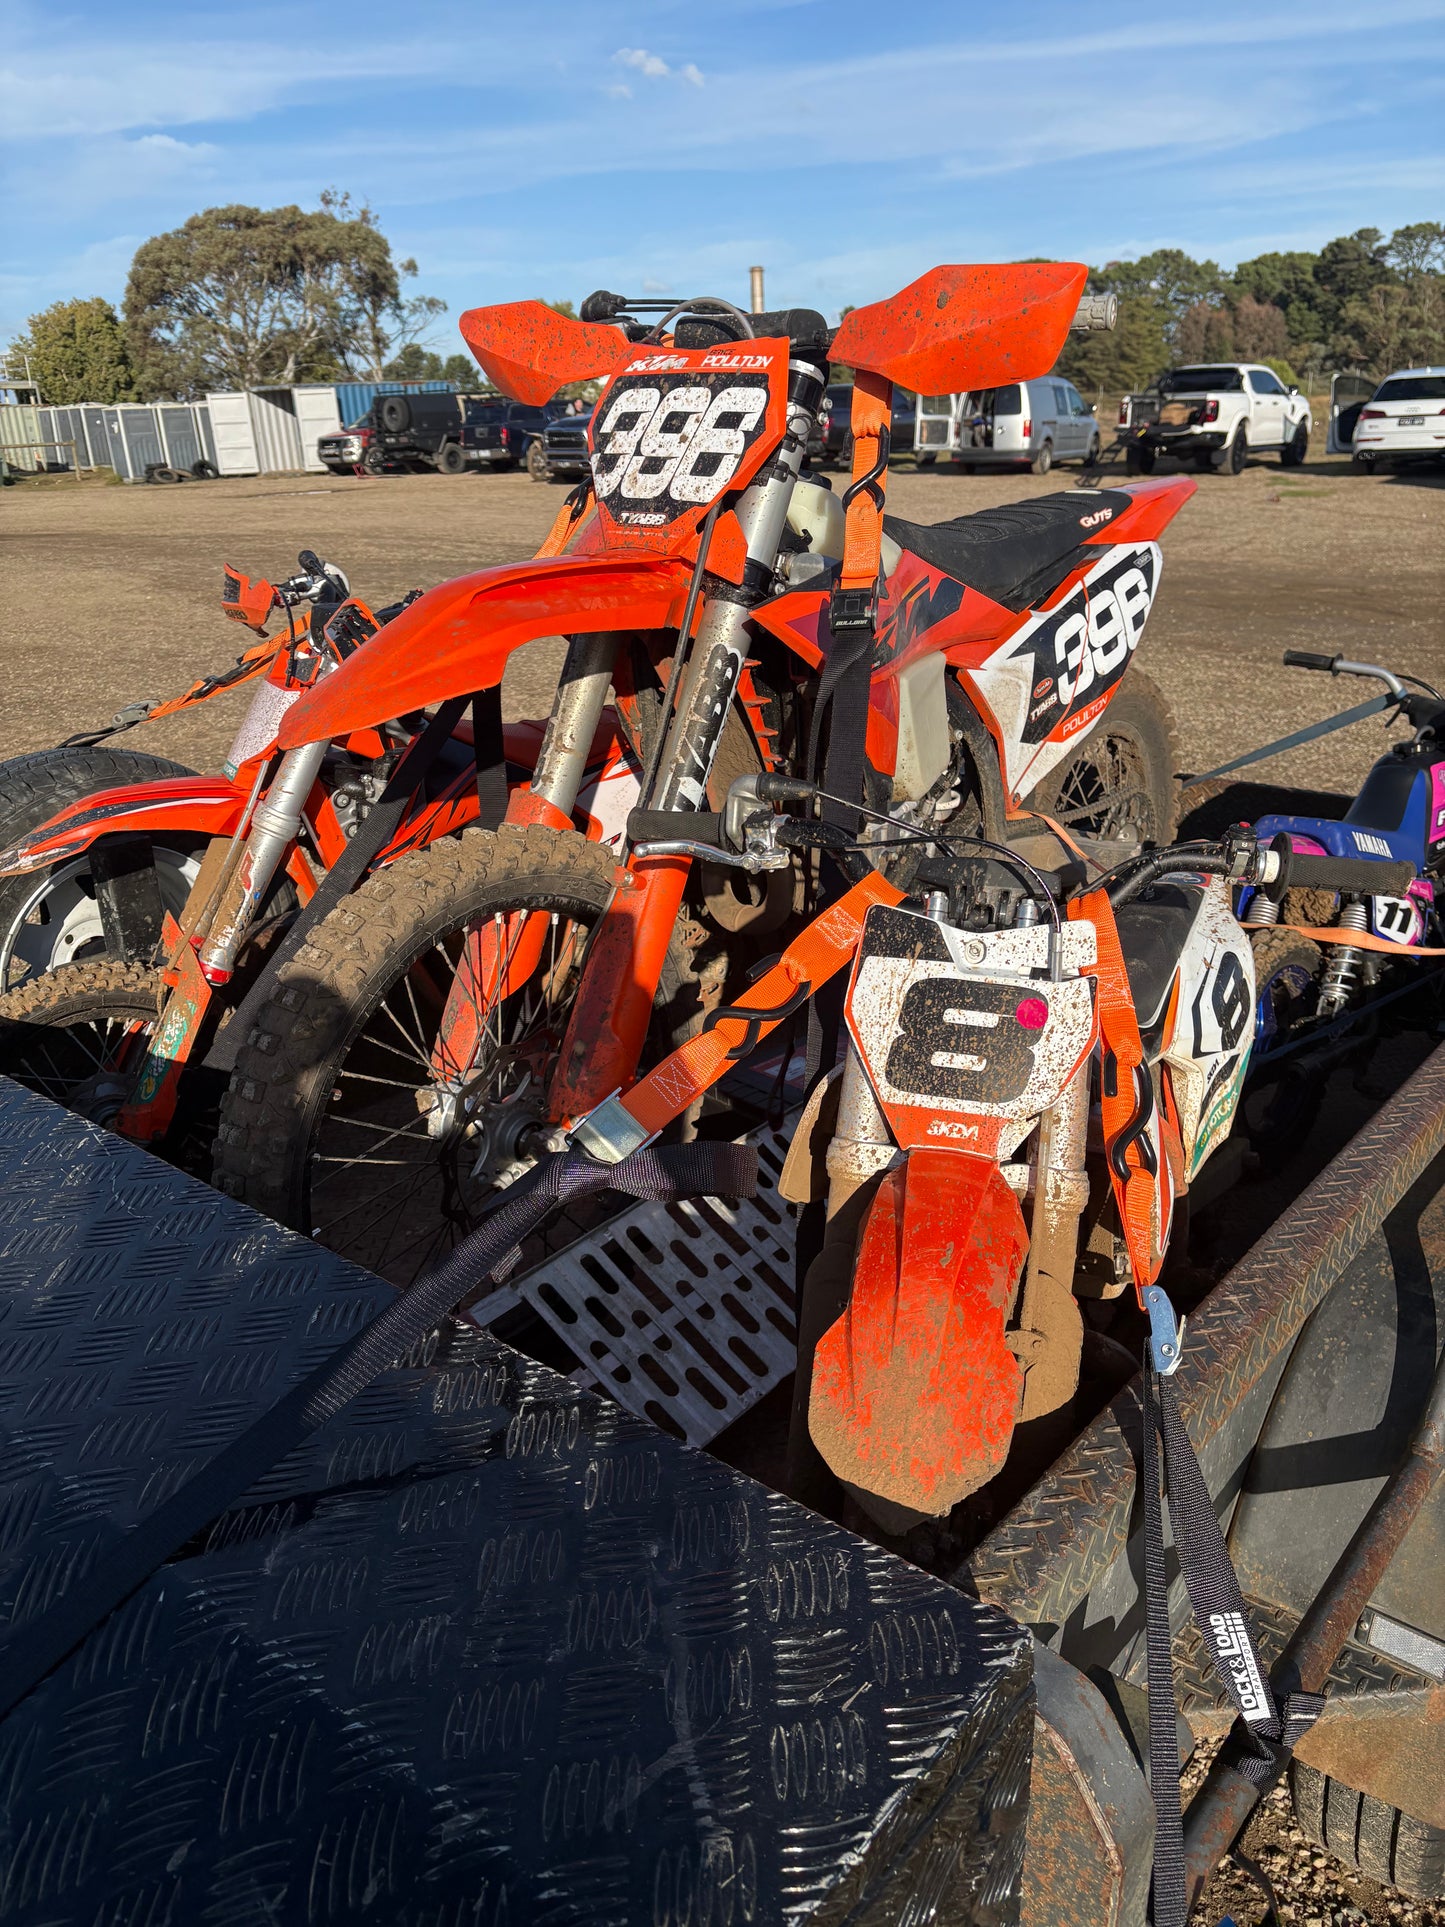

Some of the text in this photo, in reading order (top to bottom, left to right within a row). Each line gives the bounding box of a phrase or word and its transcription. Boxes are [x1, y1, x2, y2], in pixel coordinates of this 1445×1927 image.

[700, 355, 774, 368] POULTON
[618, 512, 667, 526] TYABB
[1080, 508, 1113, 528] GUTS
[1063, 695, 1108, 737] POULTON
[1352, 831, 1393, 858] YAMAHA
[1380, 901, 1415, 935] 11
[885, 977, 1049, 1104] 8
[1210, 1613, 1271, 1721] LOCK & LOAD
[1240, 1635, 1265, 1696] TRANSPORT
